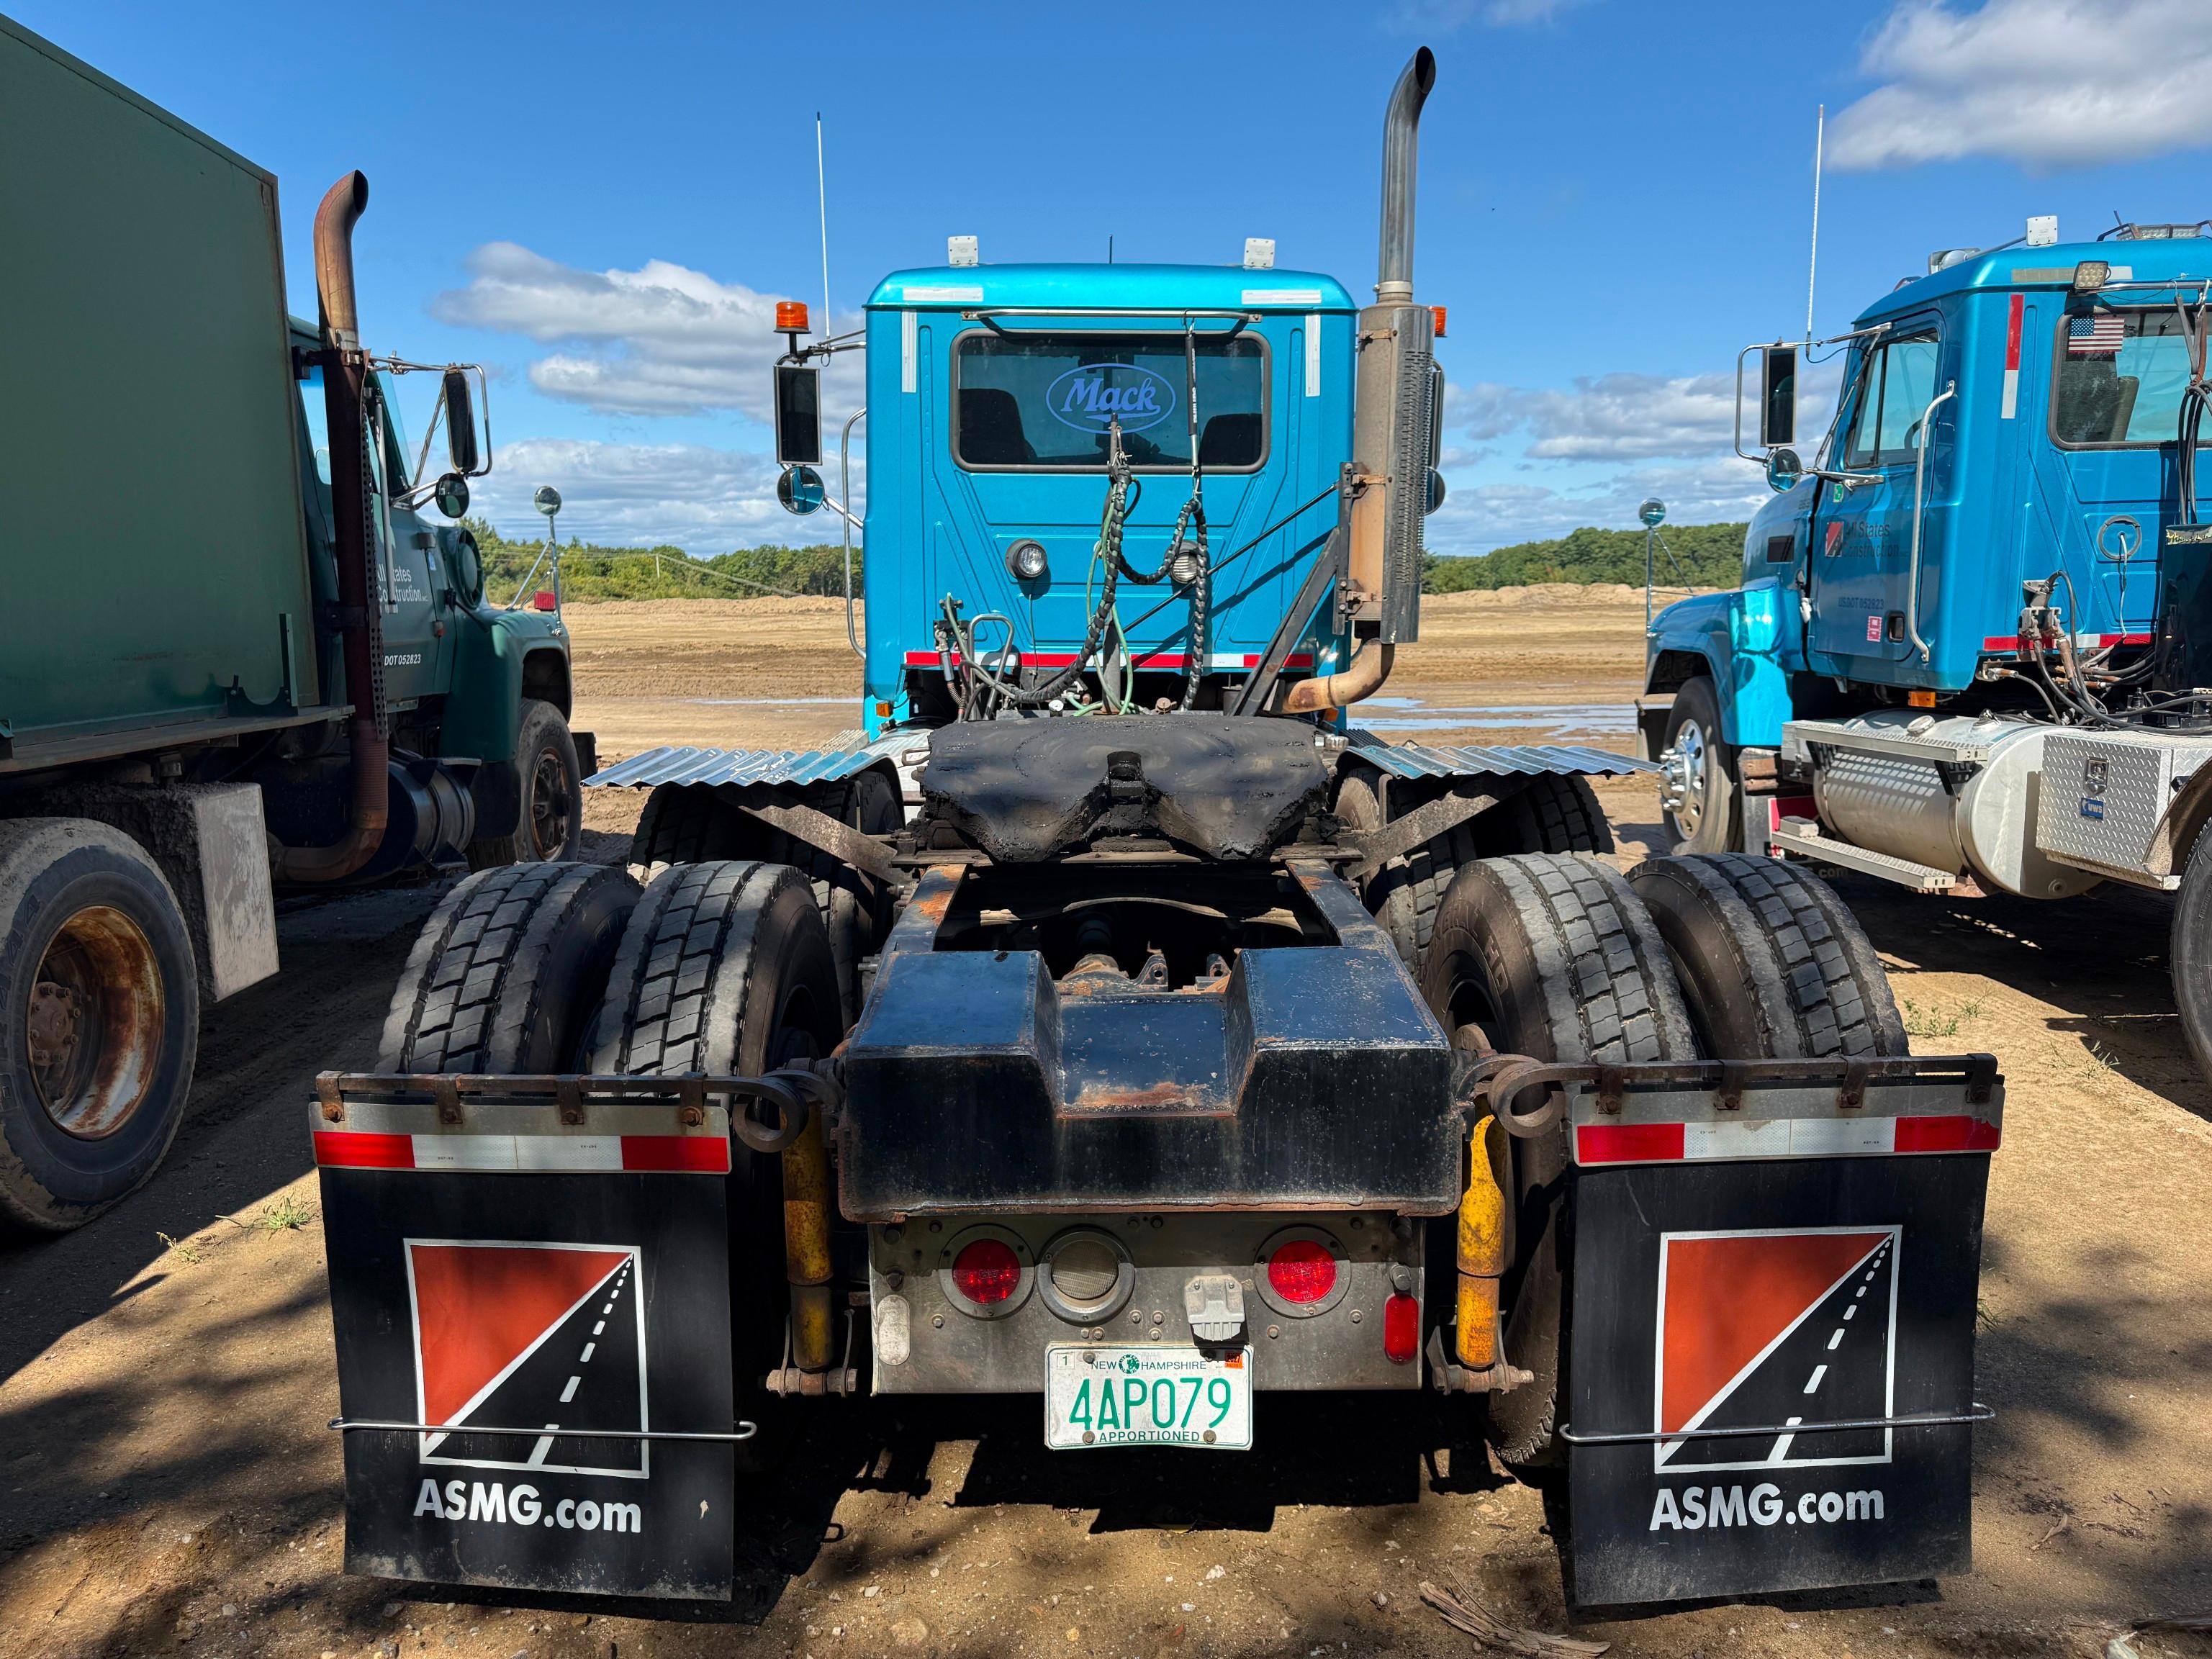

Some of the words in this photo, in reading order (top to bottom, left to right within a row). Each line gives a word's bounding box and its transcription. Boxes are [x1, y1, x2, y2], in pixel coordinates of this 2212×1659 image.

[1060, 377, 1160, 419] Mack
[1859, 521, 1890, 538] States
[393, 565, 412, 582] tates
[376, 584, 422, 602] Cotruction
[384, 655, 398, 666] DOT
[398, 654, 421, 665] 052823
[2088, 803, 2103, 814] UWS
[1062, 1355, 1068, 1365] 1
[1091, 1360, 1116, 1370] NEW
[1141, 1360, 1207, 1370] HAMPSHIRE
[1069, 1378, 1232, 1431] 4AP079
[1099, 1430, 1201, 1442] APPORTIONED
[413, 1478, 641, 1534] ASMG.com
[1648, 1483, 1884, 1532] ASMG.com
